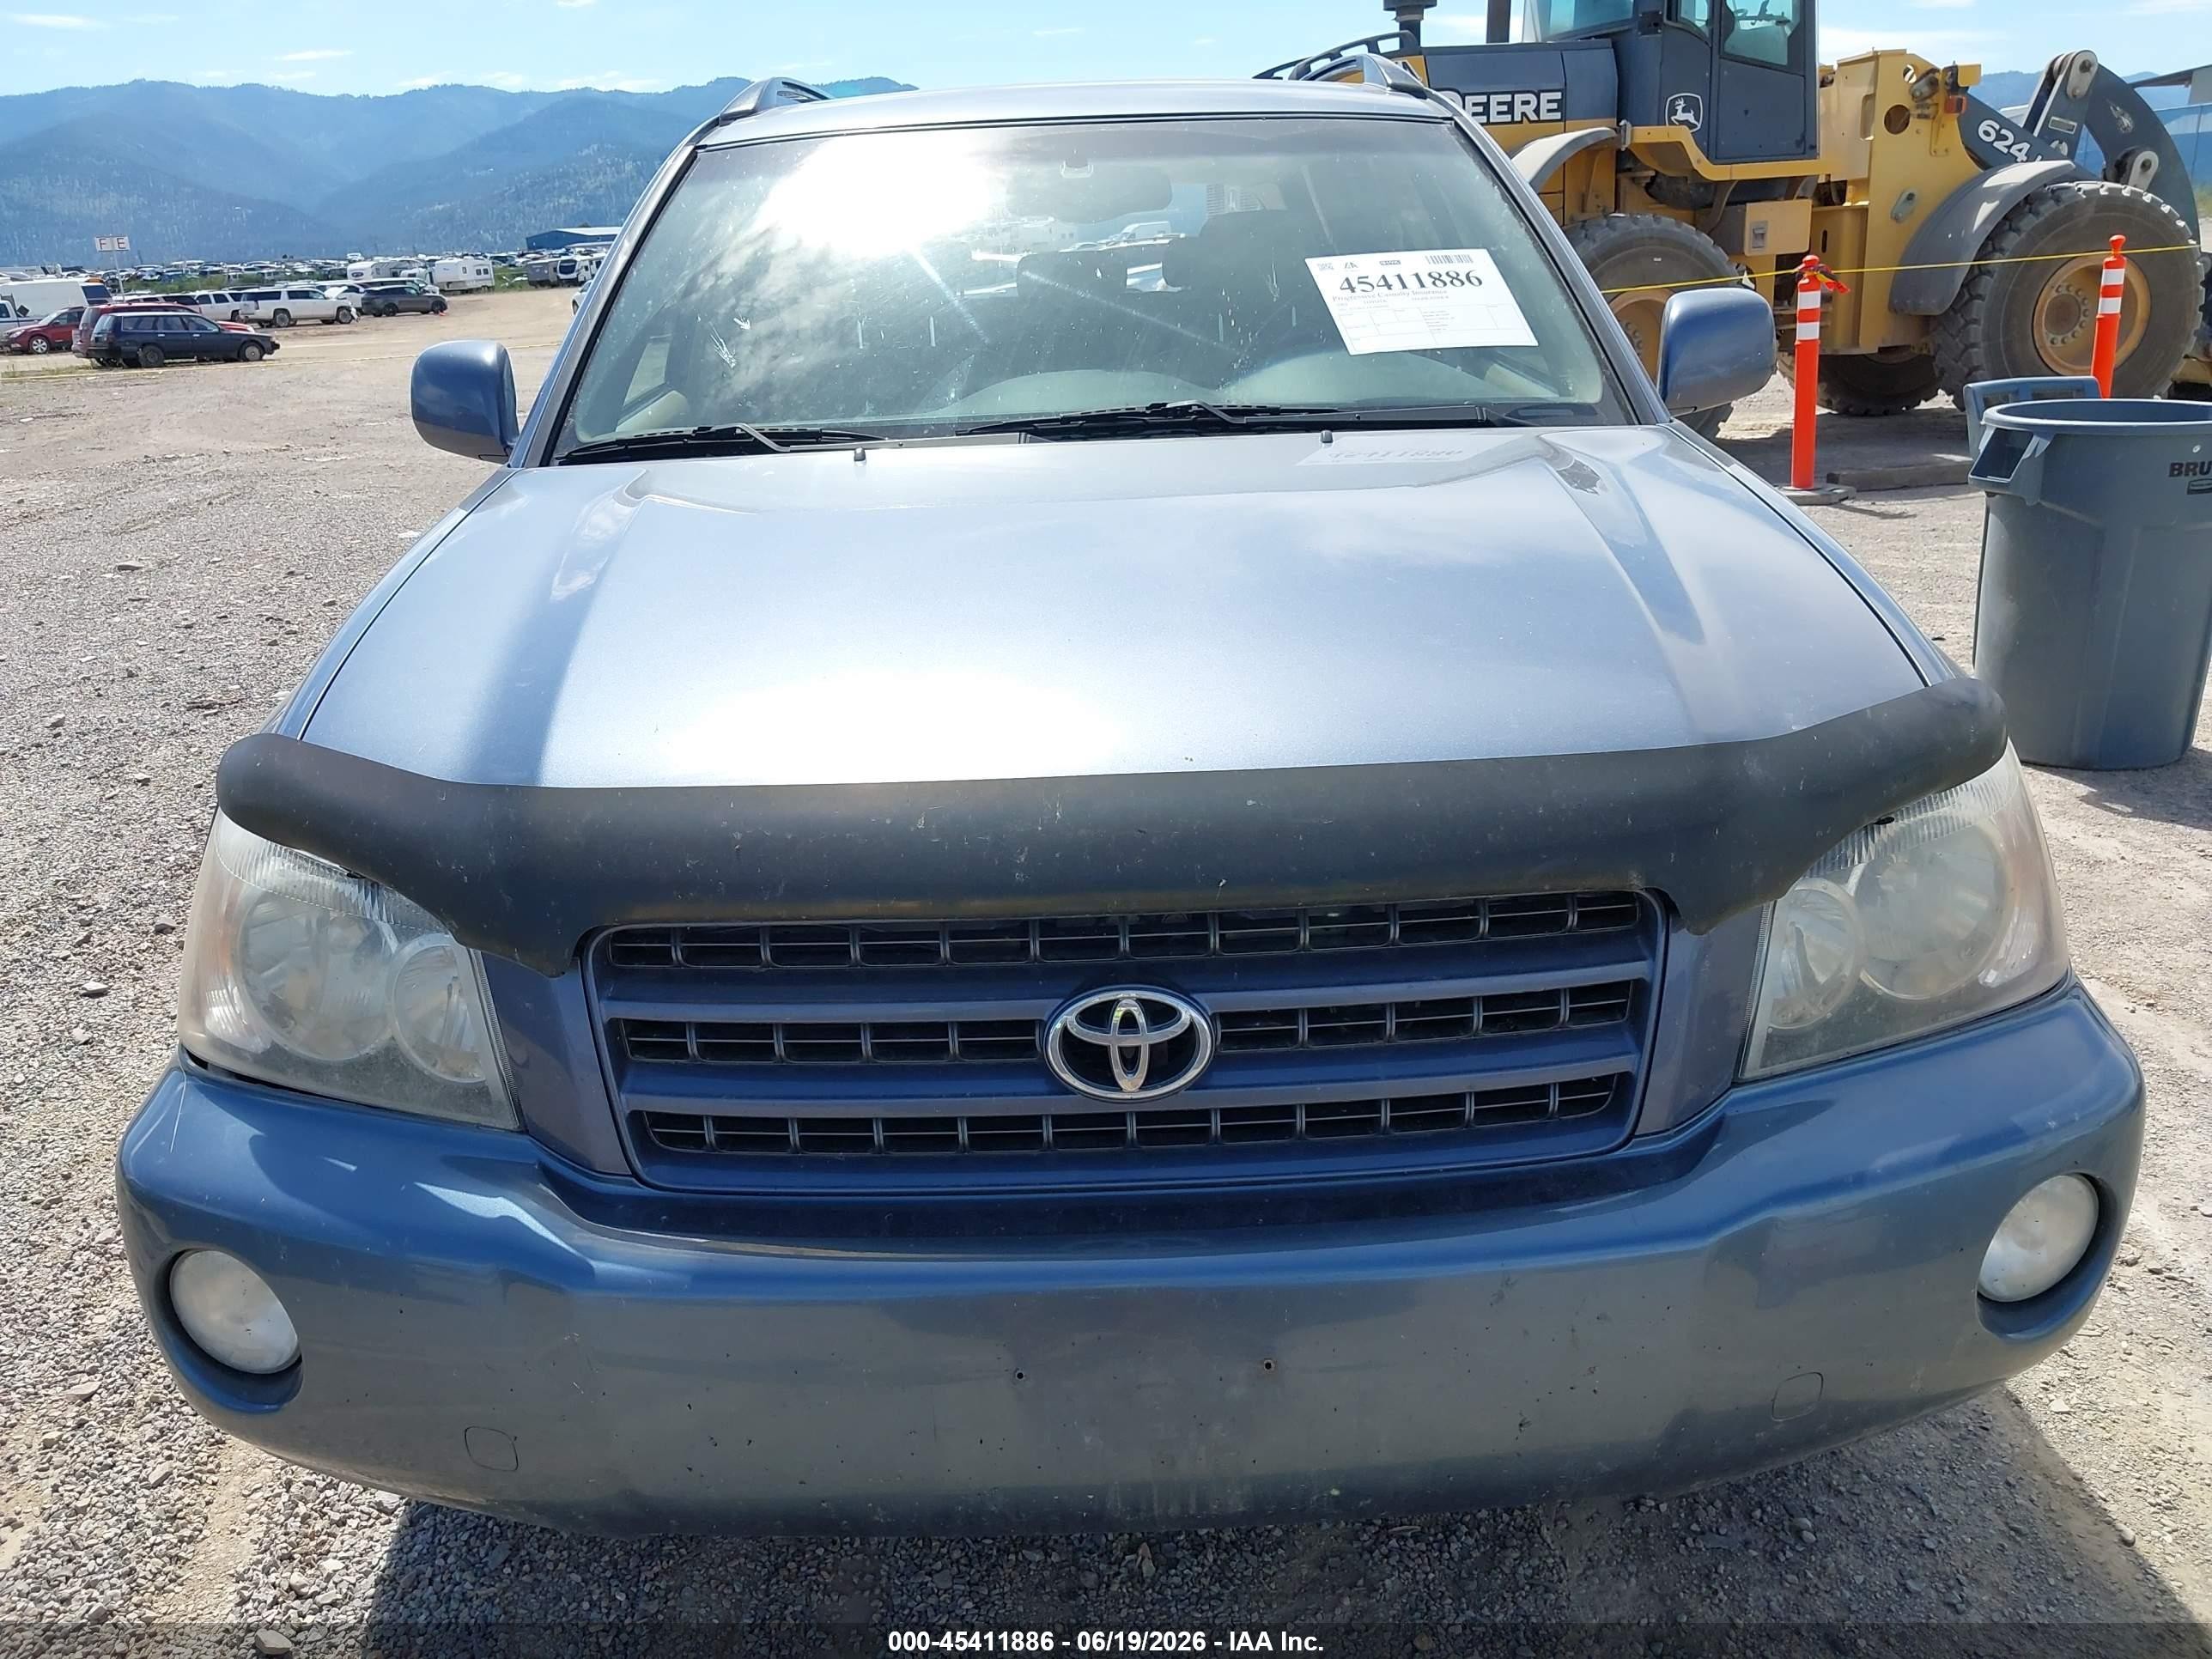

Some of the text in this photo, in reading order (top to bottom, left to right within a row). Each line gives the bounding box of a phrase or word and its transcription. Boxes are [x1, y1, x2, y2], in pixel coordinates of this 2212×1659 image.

[1978, 119, 2042, 162] 624
[99, 238, 107, 250] F
[116, 237, 126, 250] E
[1340, 270, 1483, 293] 45411886
